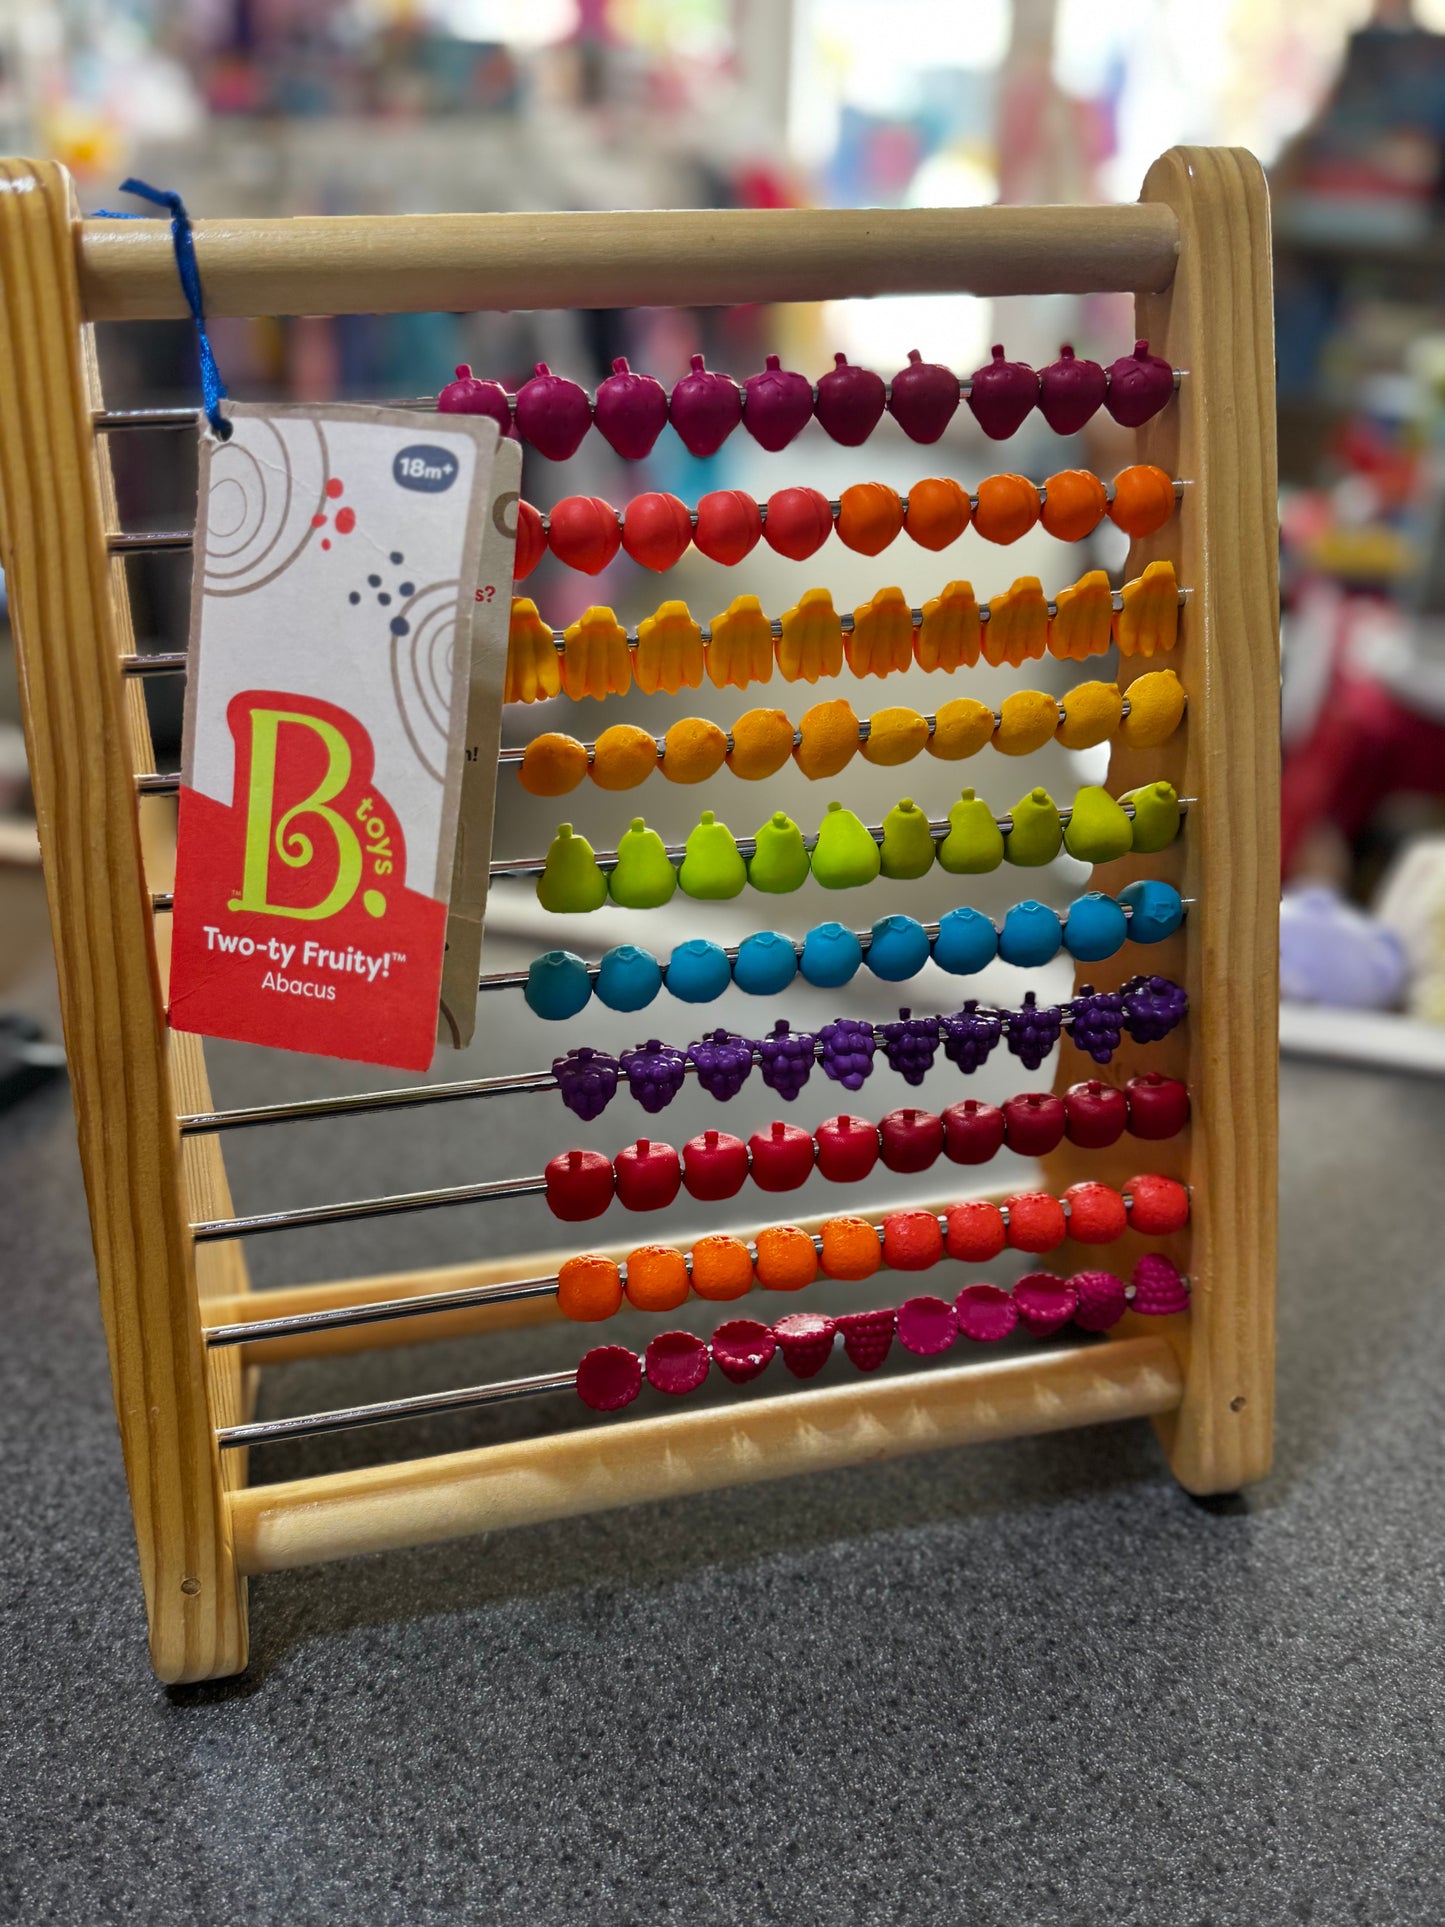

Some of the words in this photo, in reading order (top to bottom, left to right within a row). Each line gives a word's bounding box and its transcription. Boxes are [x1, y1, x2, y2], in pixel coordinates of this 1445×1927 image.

[399, 457, 454, 480] 18m+
[356, 798, 393, 876] toys
[203, 926, 296, 968] Two-ty
[262, 971, 337, 1001] Abacus
